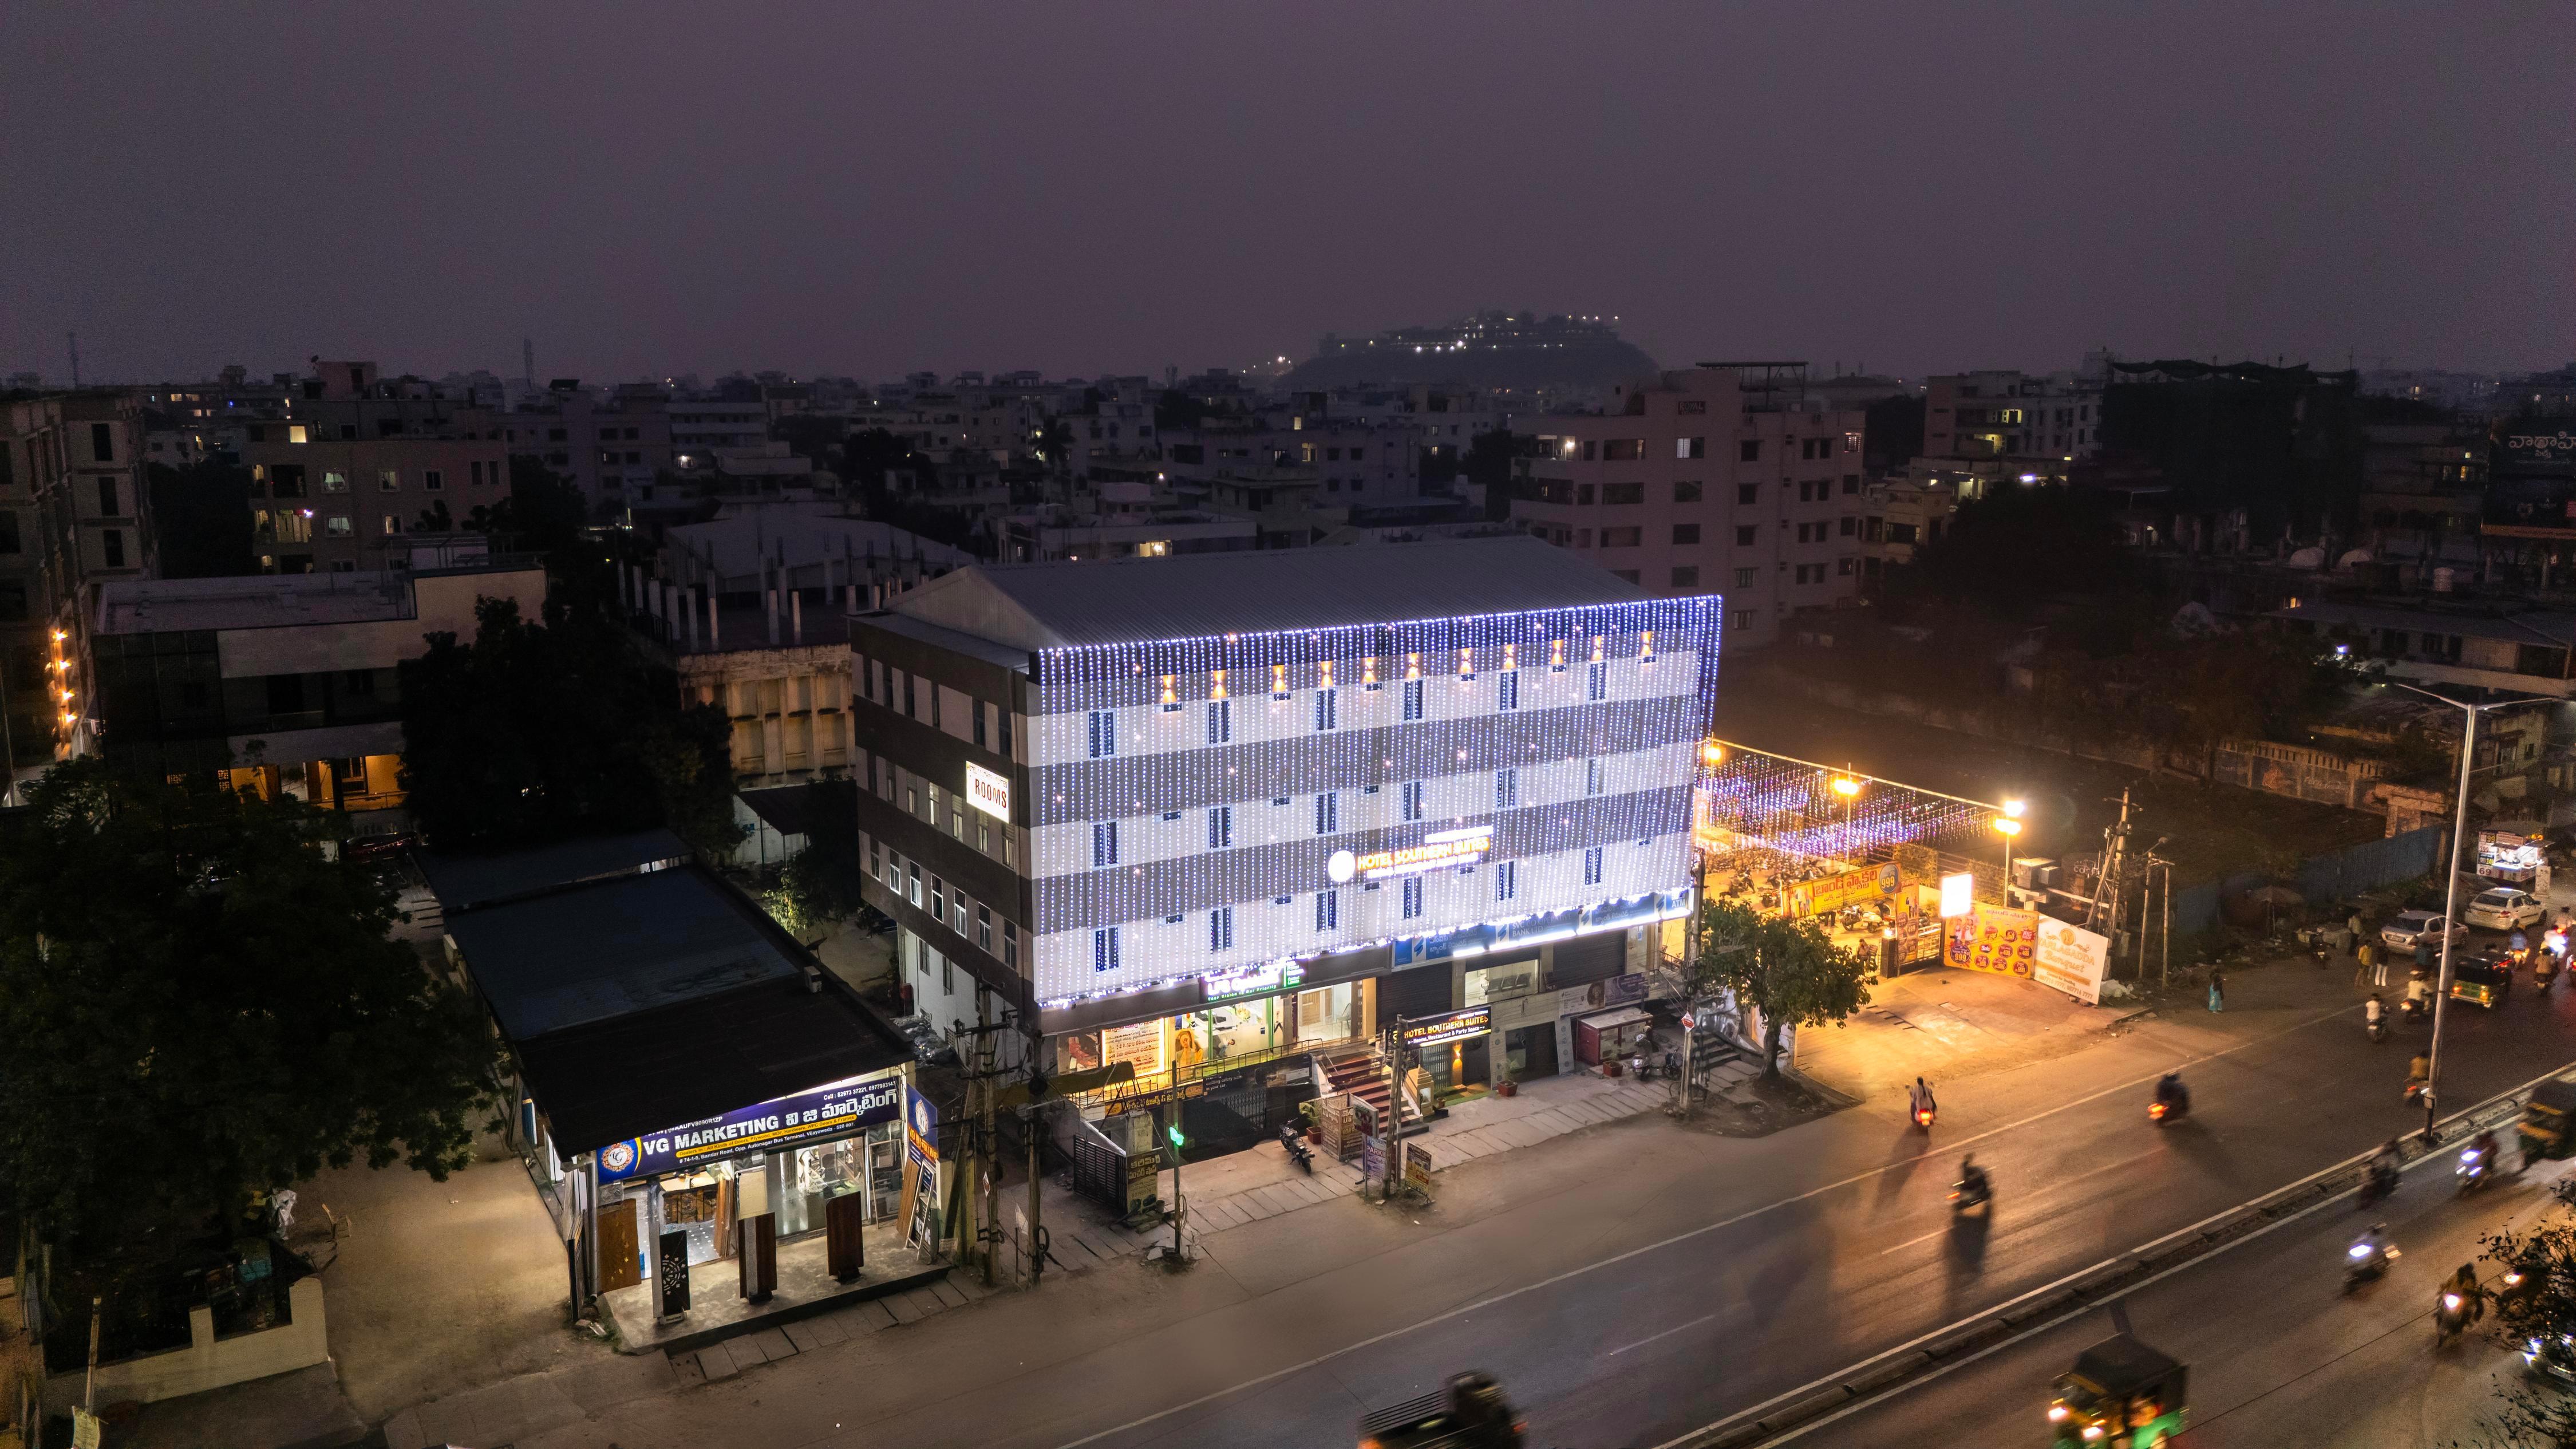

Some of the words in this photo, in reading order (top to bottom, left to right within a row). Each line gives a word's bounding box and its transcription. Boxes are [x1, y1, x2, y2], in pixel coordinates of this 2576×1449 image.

[975, 778, 1006, 808] ROOMS
[1358, 852, 1393, 870] HOTEL
[1395, 842, 1452, 865] SOUTHERN
[1453, 836, 1490, 852] SUITES
[2479, 867, 2491, 875] 69
[1881, 876, 1895, 889] 999
[1672, 898, 1686, 909] ATM
[1512, 921, 1524, 929] SVC
[1512, 929, 1530, 937] BANK
[1954, 953, 1967, 961] 999
[2044, 949, 2085, 973] Banquet
[1404, 1027, 1427, 1039] HOTEL
[1465, 1016, 1488, 1026] SUITES
[1428, 1032, 1451, 1041] Restaurant
[1455, 1028, 1467, 1036] Party
[837, 1089, 852, 1097] 82973
[852, 1087, 868, 1095] 37221,
[803, 1109, 817, 1123] జి
[821, 1088, 898, 1116] మార్కెటింగ్
[643, 1138, 669, 1156] VG
[674, 1115, 779, 1150] MARKETING
[750, 1133, 772, 1142] Plywood,
[784, 1126, 807, 1135] Hardware,
[701, 1151, 719, 1160] Bandar
[748, 1140, 773, 1150] Autonagar
[784, 1133, 806, 1142] Terminal,
[1367, 1146, 1386, 1157] PARKI
